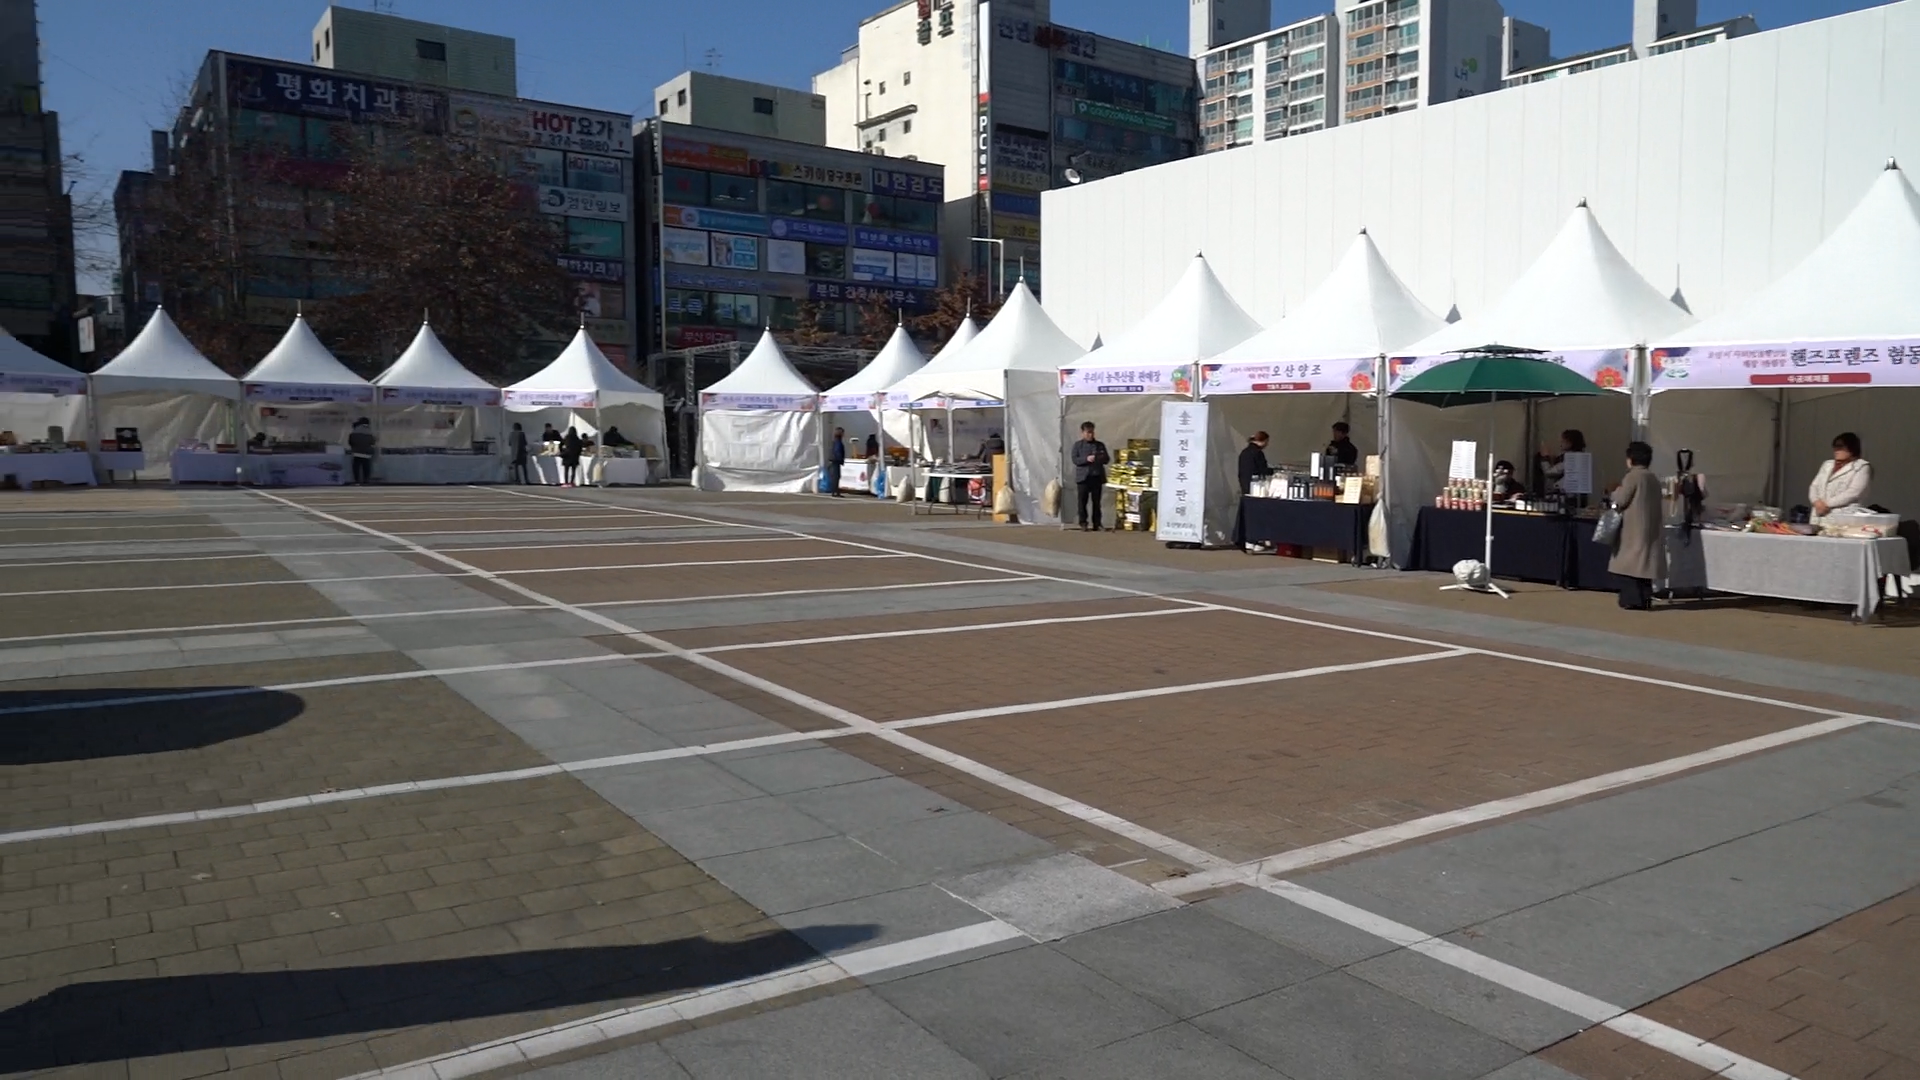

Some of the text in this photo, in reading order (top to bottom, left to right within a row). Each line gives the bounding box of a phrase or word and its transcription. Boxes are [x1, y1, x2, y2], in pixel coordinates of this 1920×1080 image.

[276, 72, 399, 114] 평화치과
[874, 169, 942, 195] 대한검도
[567, 196, 620, 213] 경인일보
[1272, 363, 1322, 377] 오산양조
